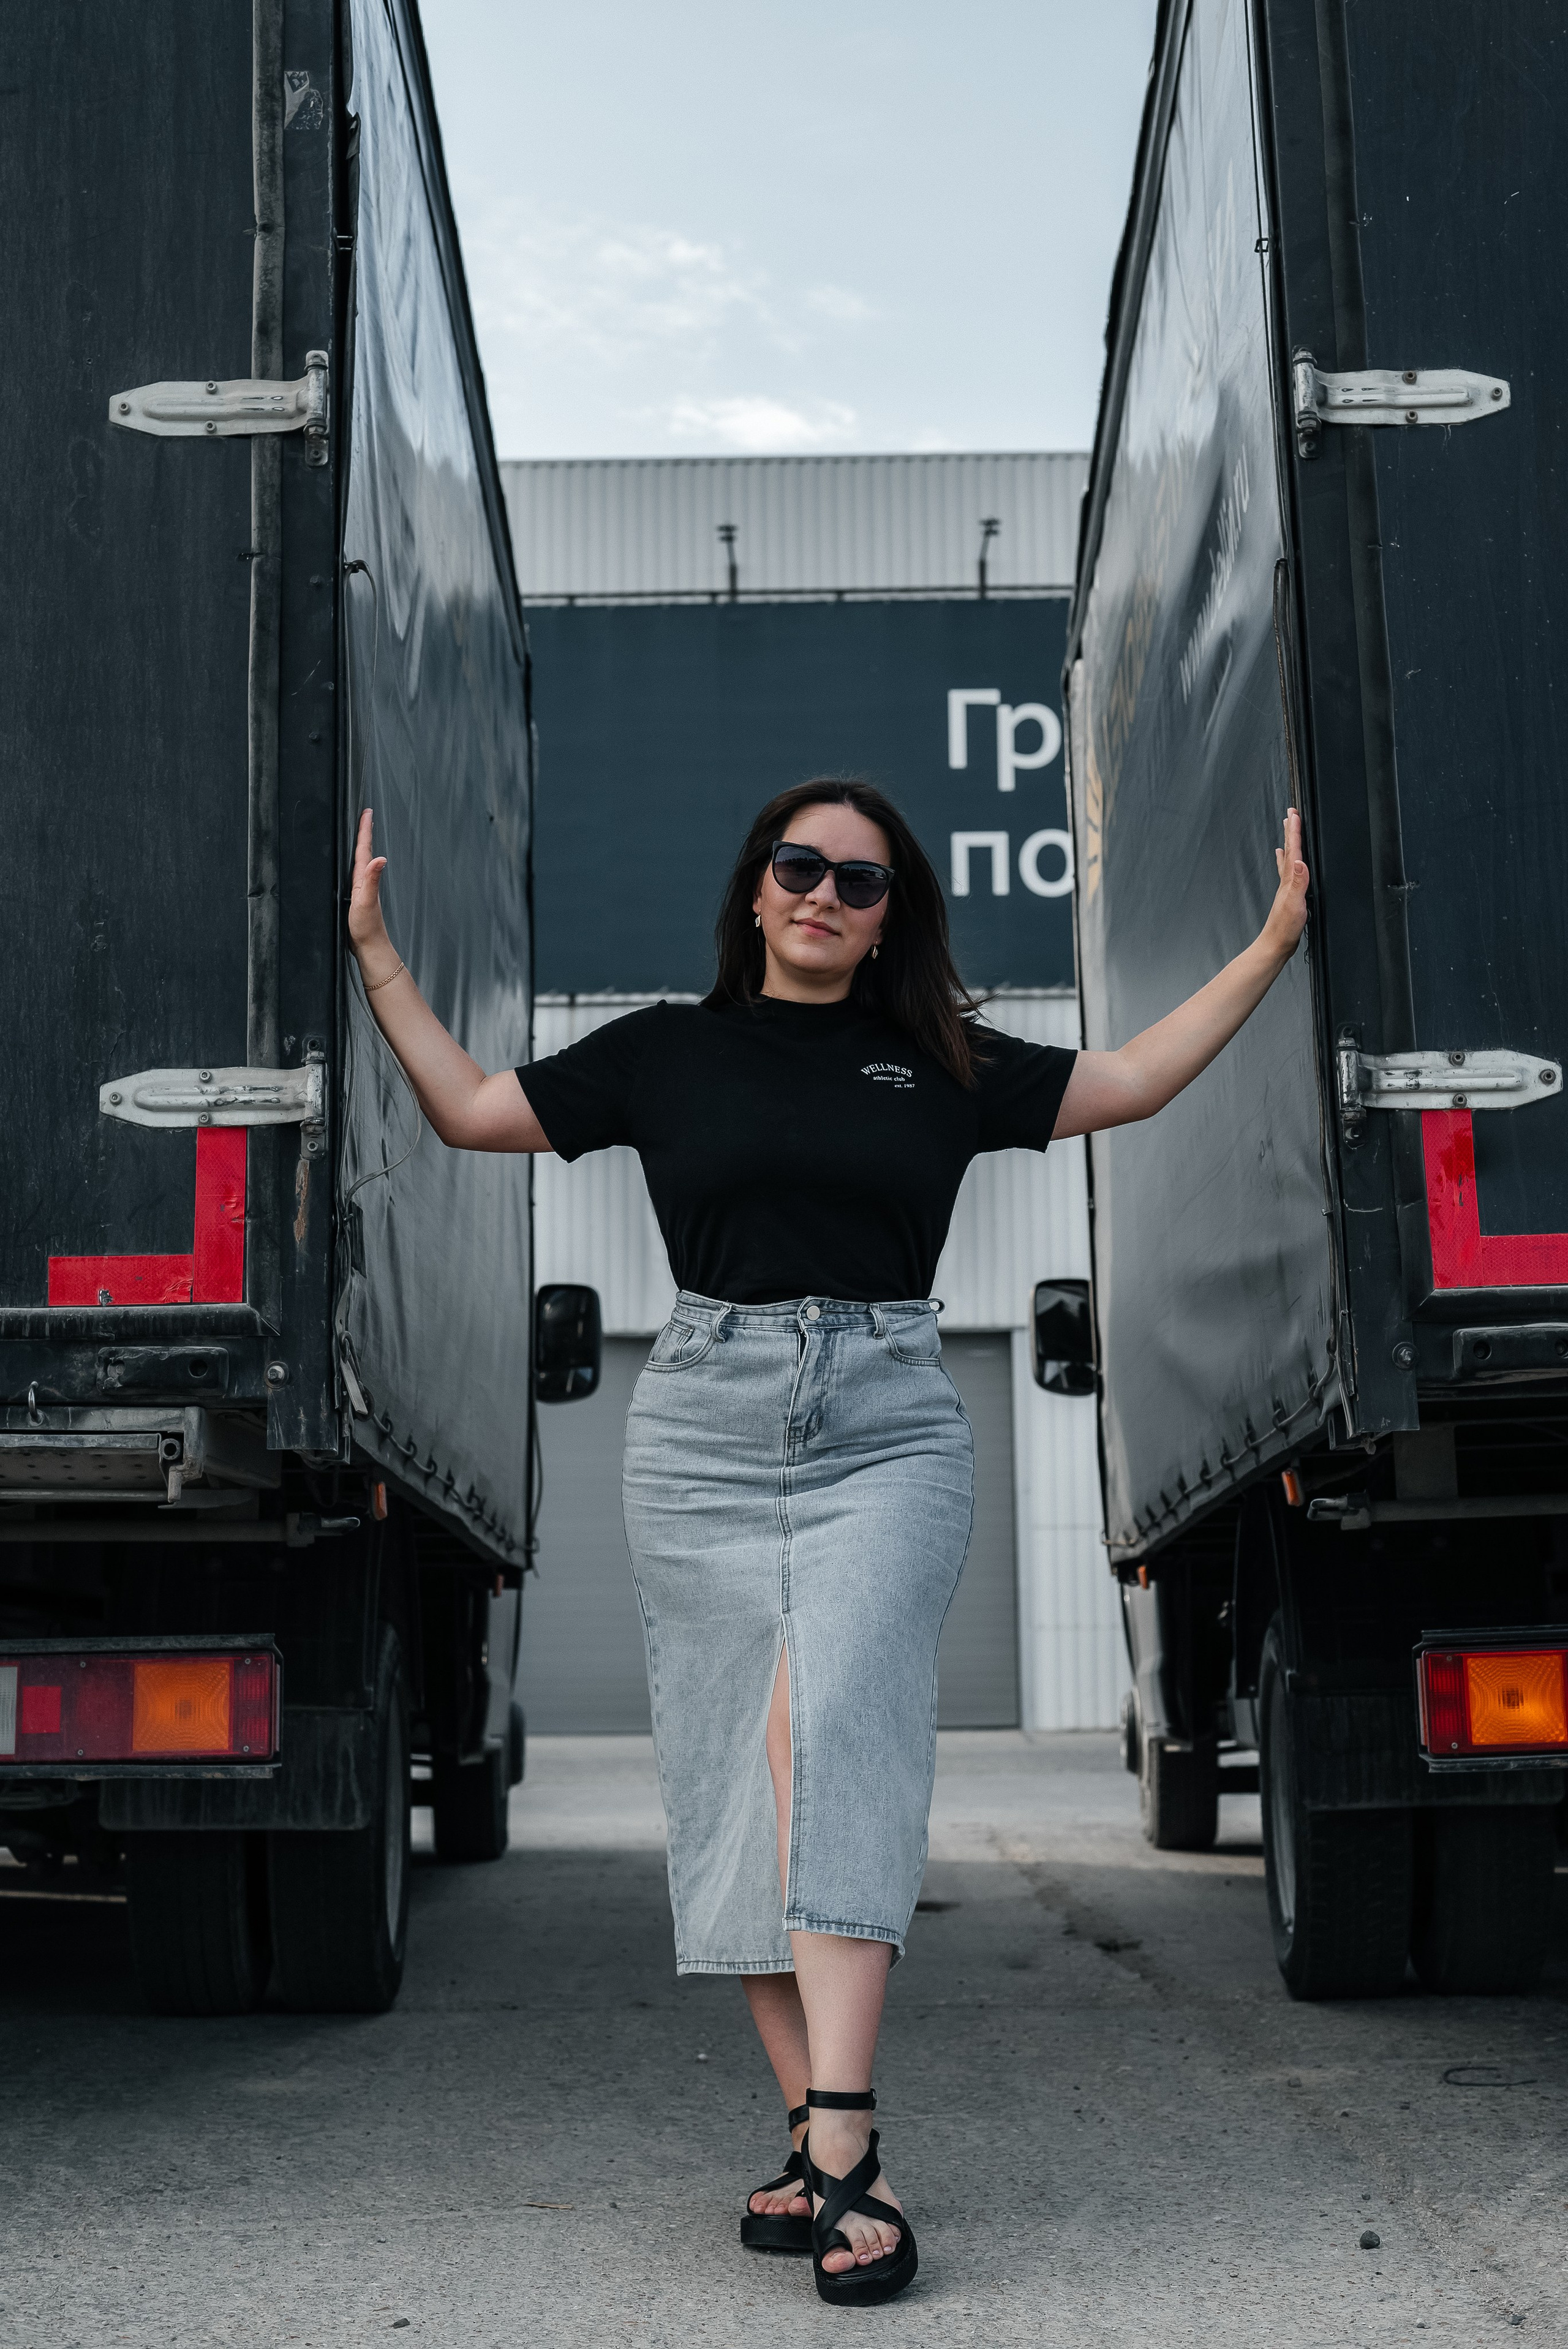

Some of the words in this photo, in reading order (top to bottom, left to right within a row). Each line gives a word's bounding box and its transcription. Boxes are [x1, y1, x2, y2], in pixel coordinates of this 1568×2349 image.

[948, 688, 1062, 792] Гр
[951, 828, 1075, 898] по
[861, 1063, 913, 1077] WELLNESS
